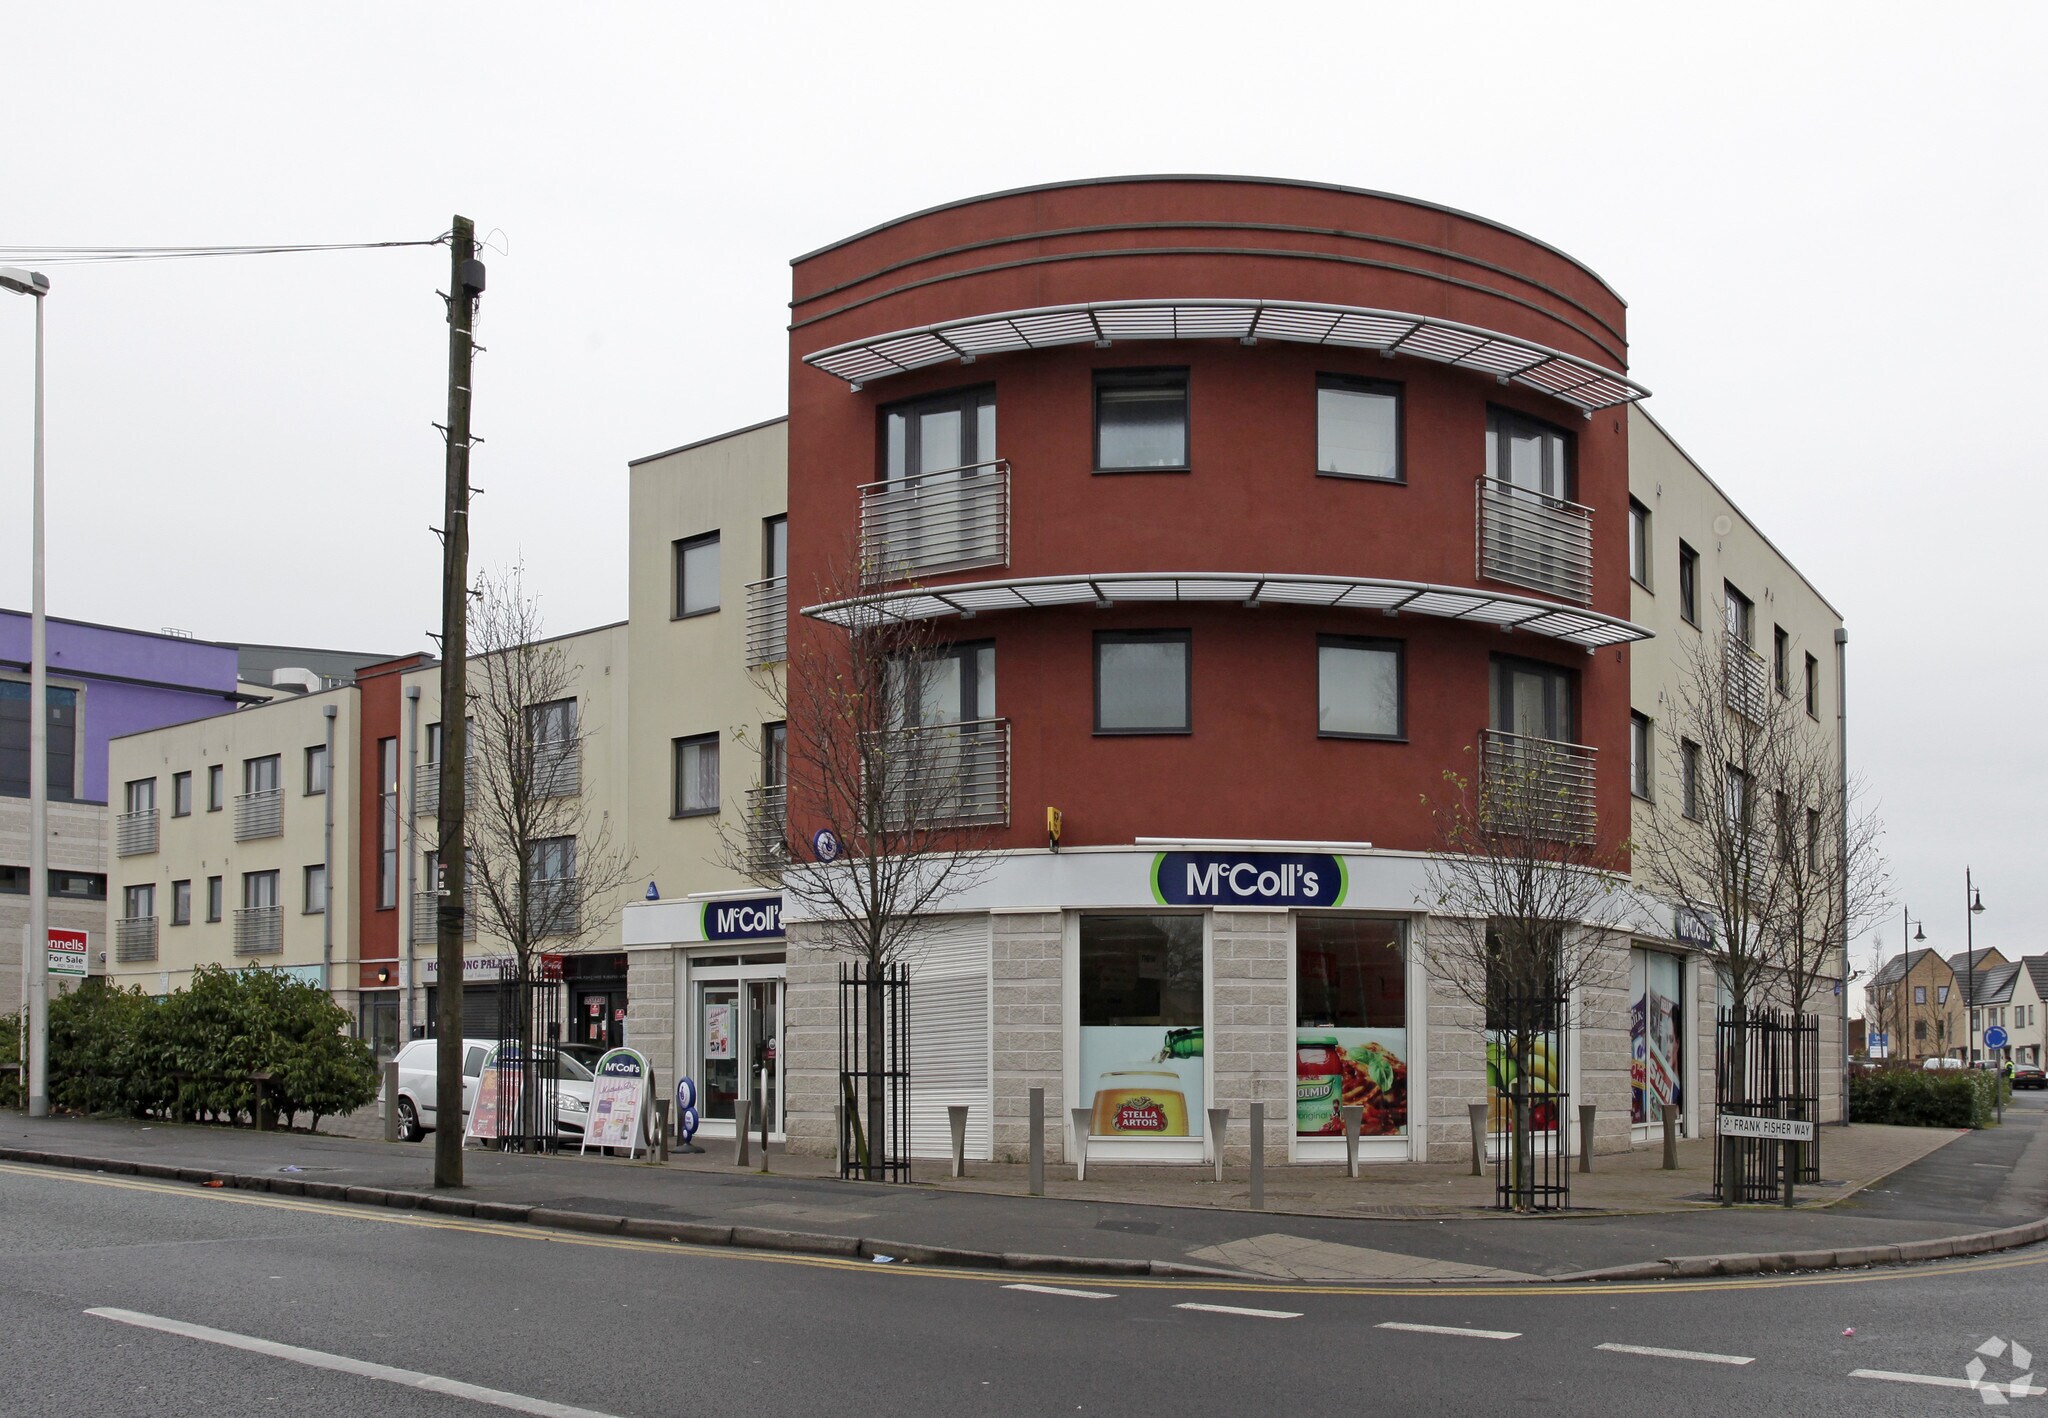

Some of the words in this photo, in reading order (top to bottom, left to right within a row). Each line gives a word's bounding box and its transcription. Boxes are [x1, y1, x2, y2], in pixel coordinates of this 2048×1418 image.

[1186, 862, 1319, 897] McColl's
[48, 939, 84, 951] nnells
[49, 954, 63, 962] For
[66, 956, 84, 965] Sale
[605, 1062, 640, 1074] McColl's
[1297, 1085, 1330, 1098] OLMIO
[1122, 1110, 1158, 1119] STELLA
[1122, 1118, 1158, 1127] ARTOIS
[1734, 1118, 1761, 1133] FRANK
[1763, 1121, 1792, 1135] FISHER
[1794, 1124, 1810, 1136] WAY
